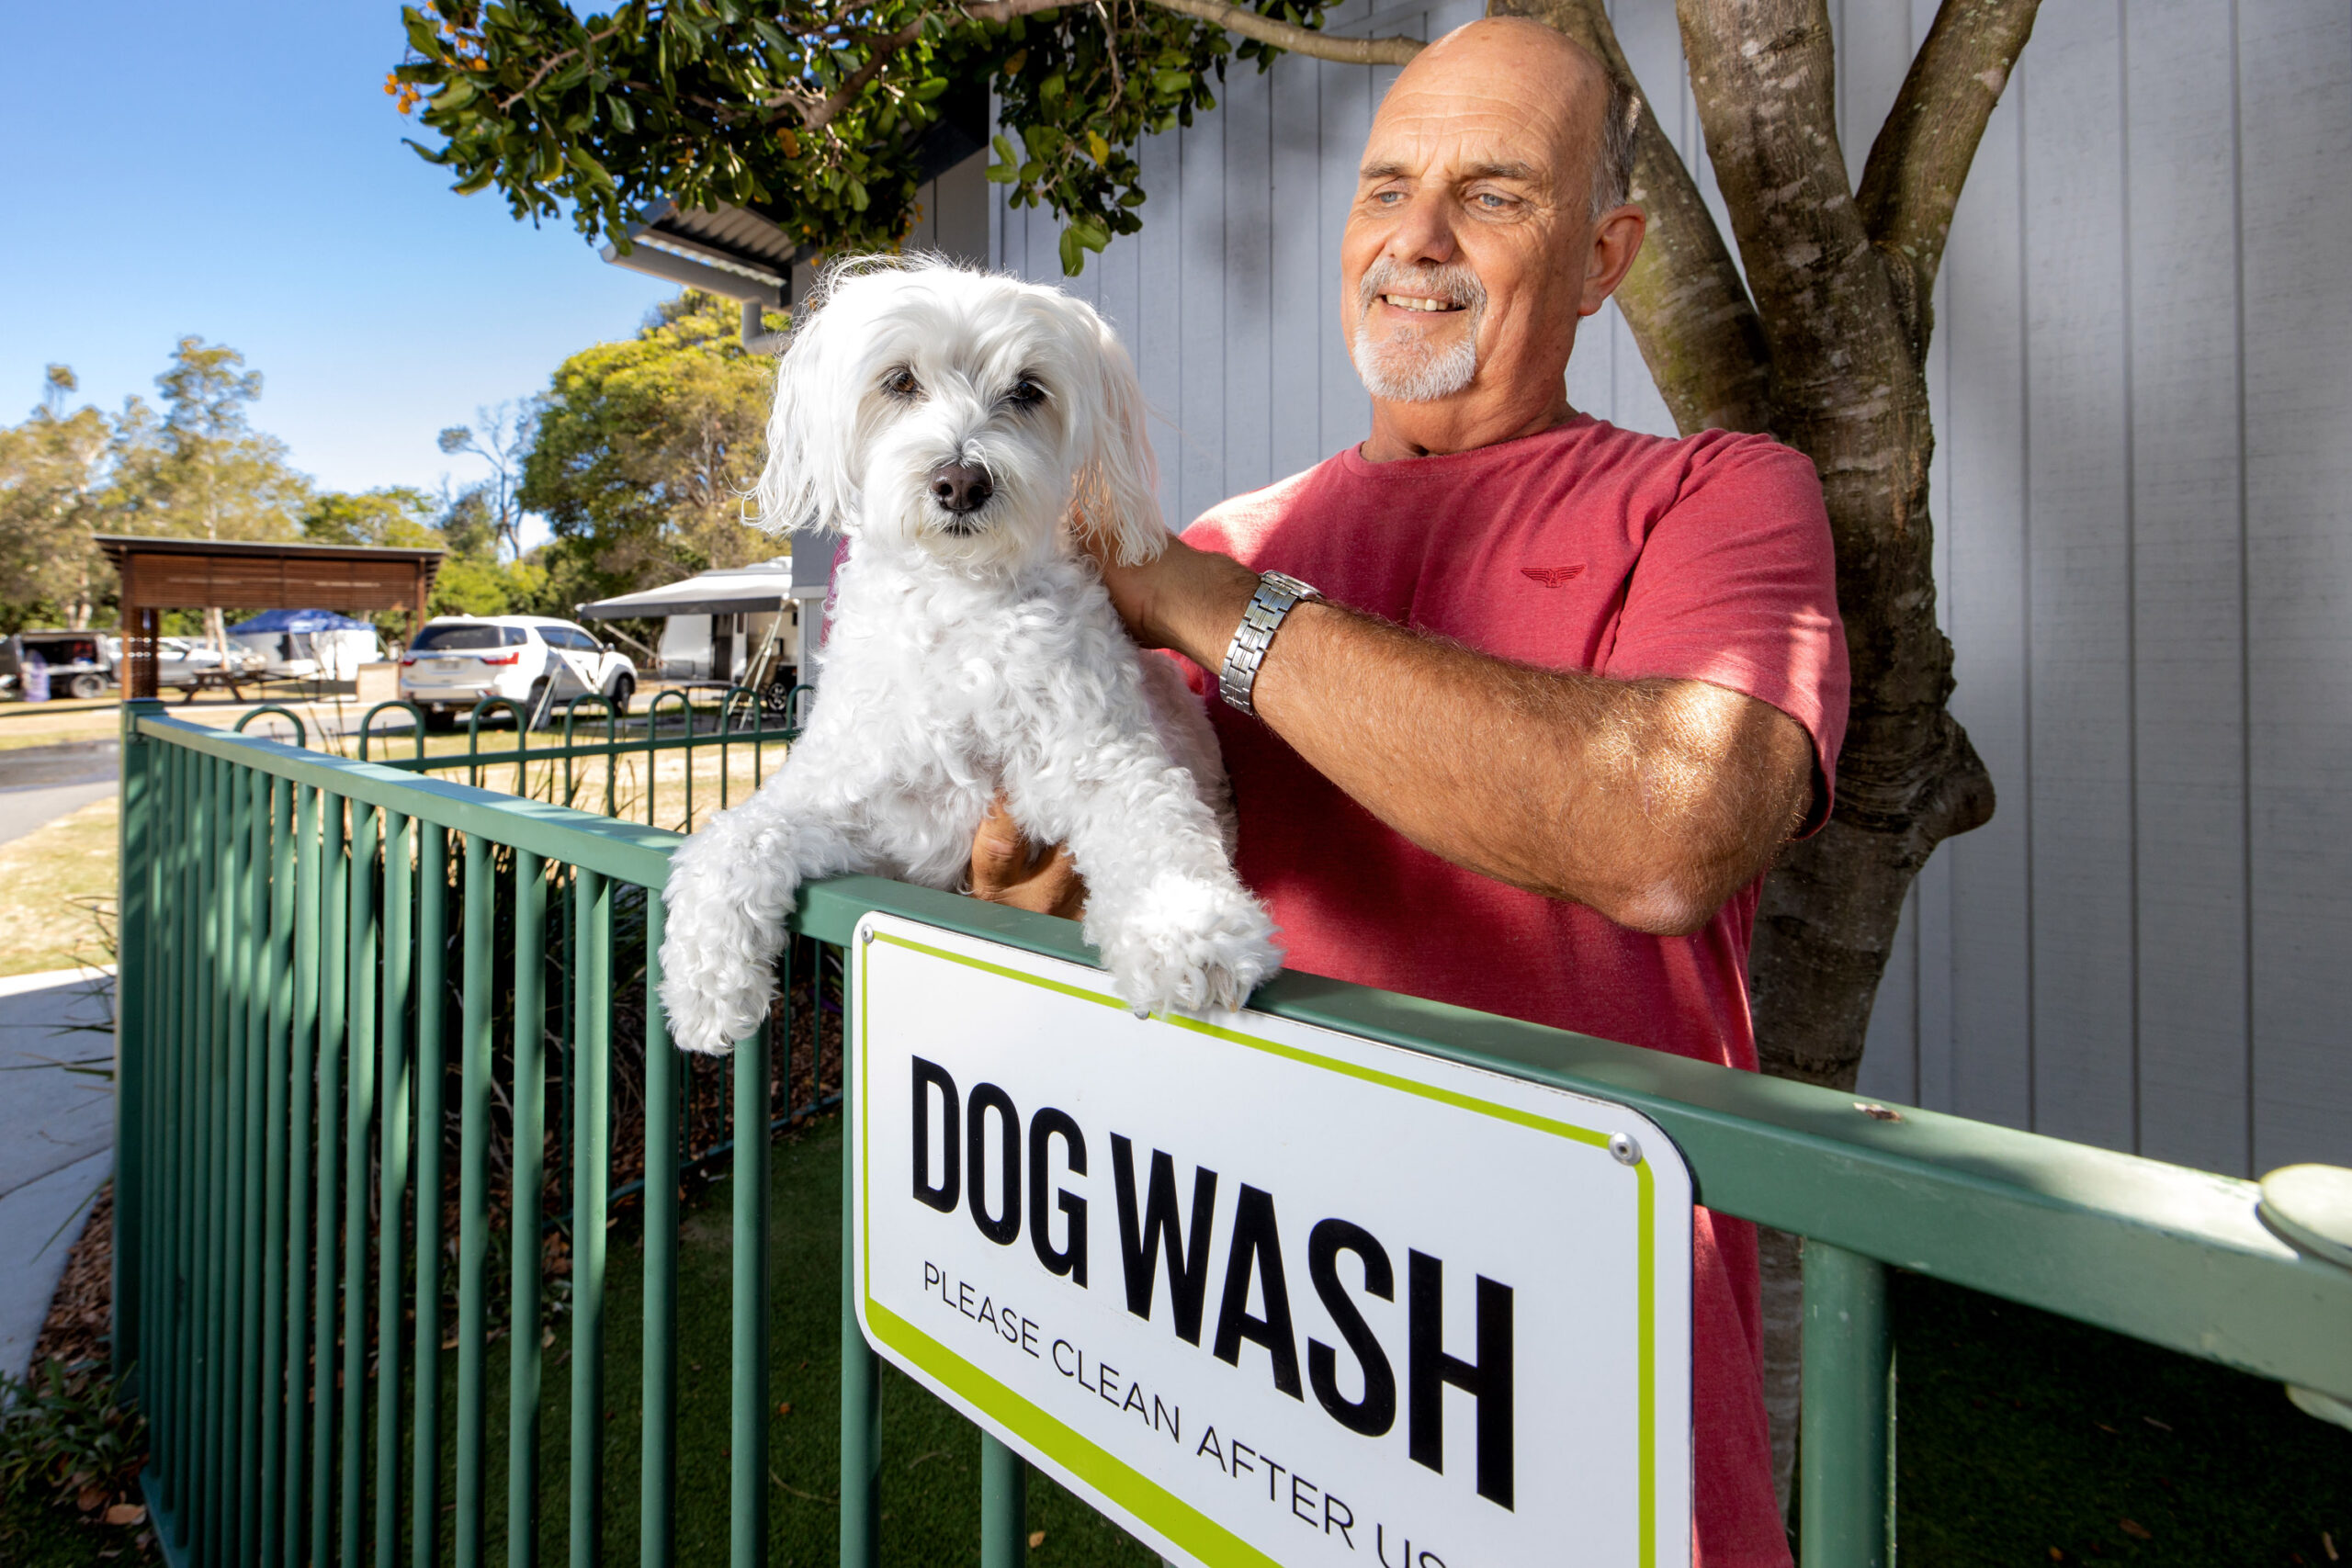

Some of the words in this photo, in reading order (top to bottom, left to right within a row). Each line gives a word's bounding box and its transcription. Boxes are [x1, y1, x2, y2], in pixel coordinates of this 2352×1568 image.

[911, 1055, 1089, 1290] DOG
[1109, 1131, 1515, 1513] WASH
[924, 1260, 1040, 1359] PLEASE
[1052, 1338, 1180, 1444] CLEAN
[1196, 1425, 1355, 1551] AFTER
